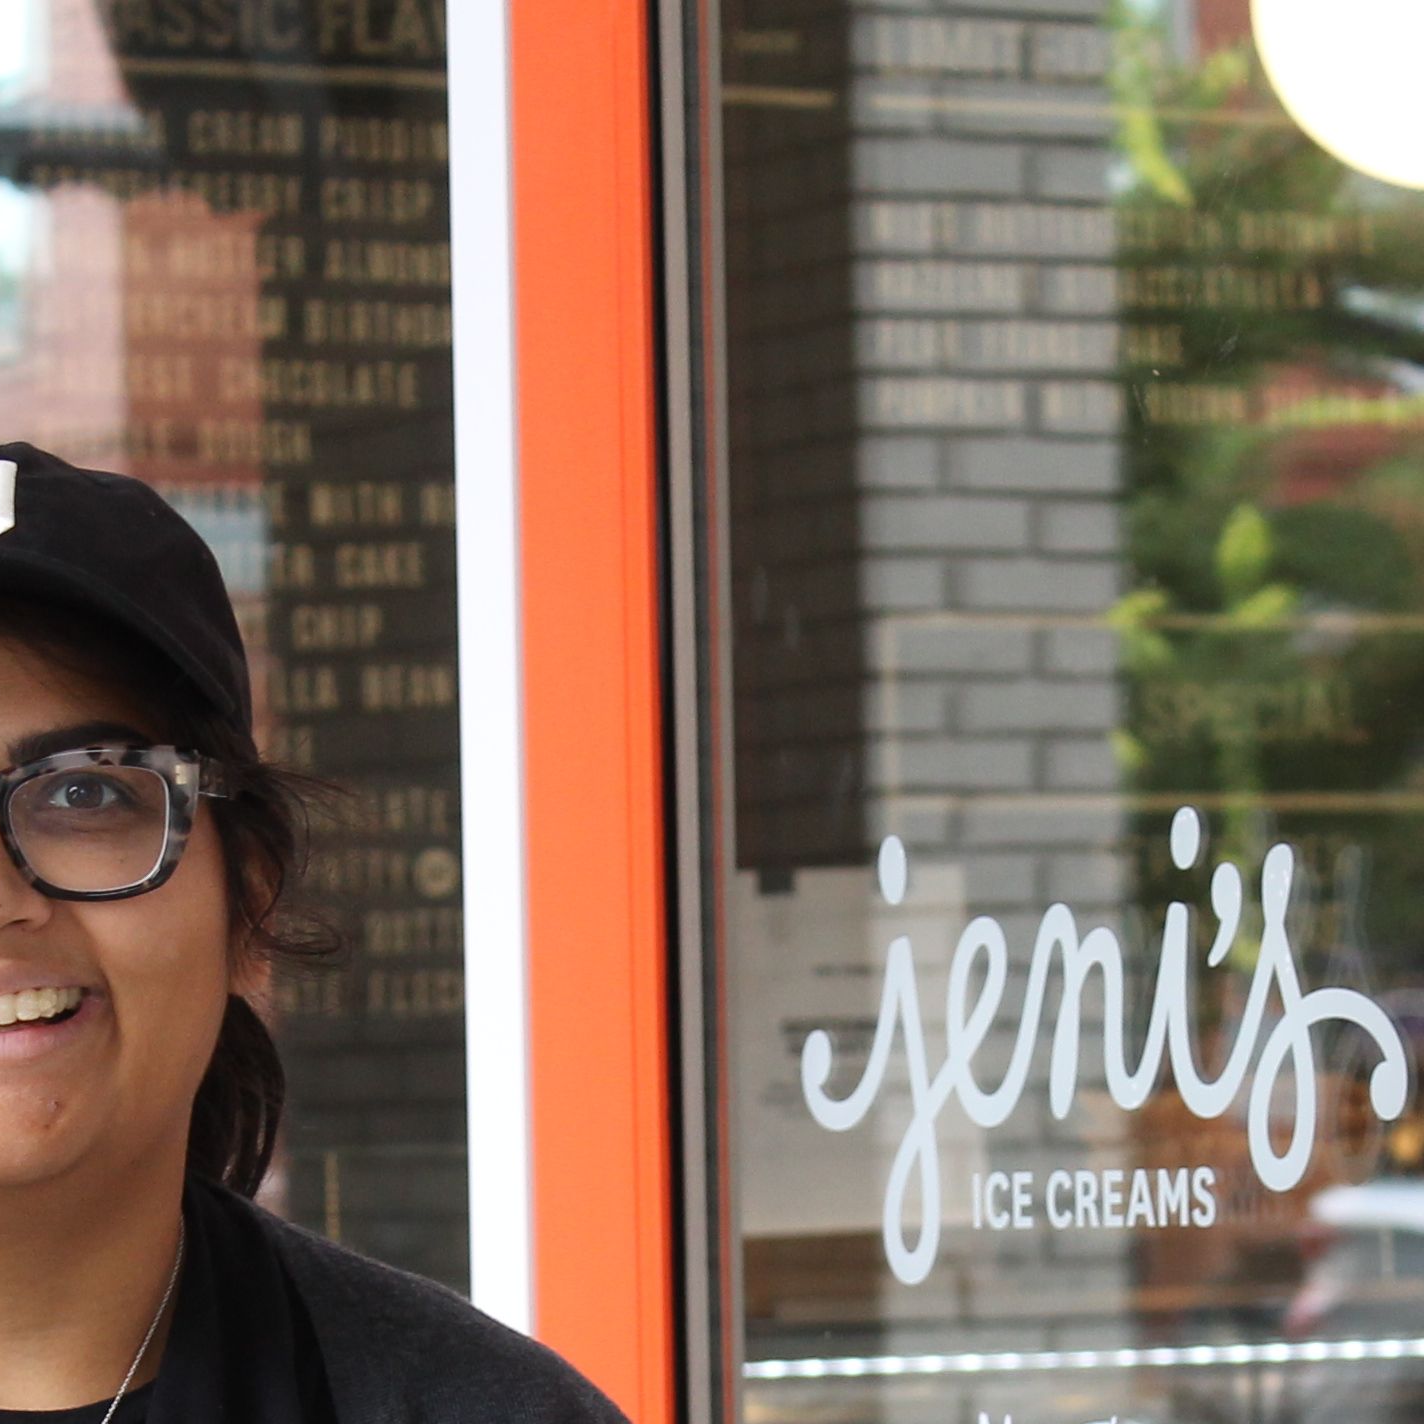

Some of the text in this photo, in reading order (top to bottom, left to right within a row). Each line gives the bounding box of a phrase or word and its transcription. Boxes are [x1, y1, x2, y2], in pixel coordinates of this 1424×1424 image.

[801, 806, 1408, 1286] jeni's
[972, 1167, 1216, 1230] ICE CREAMS
